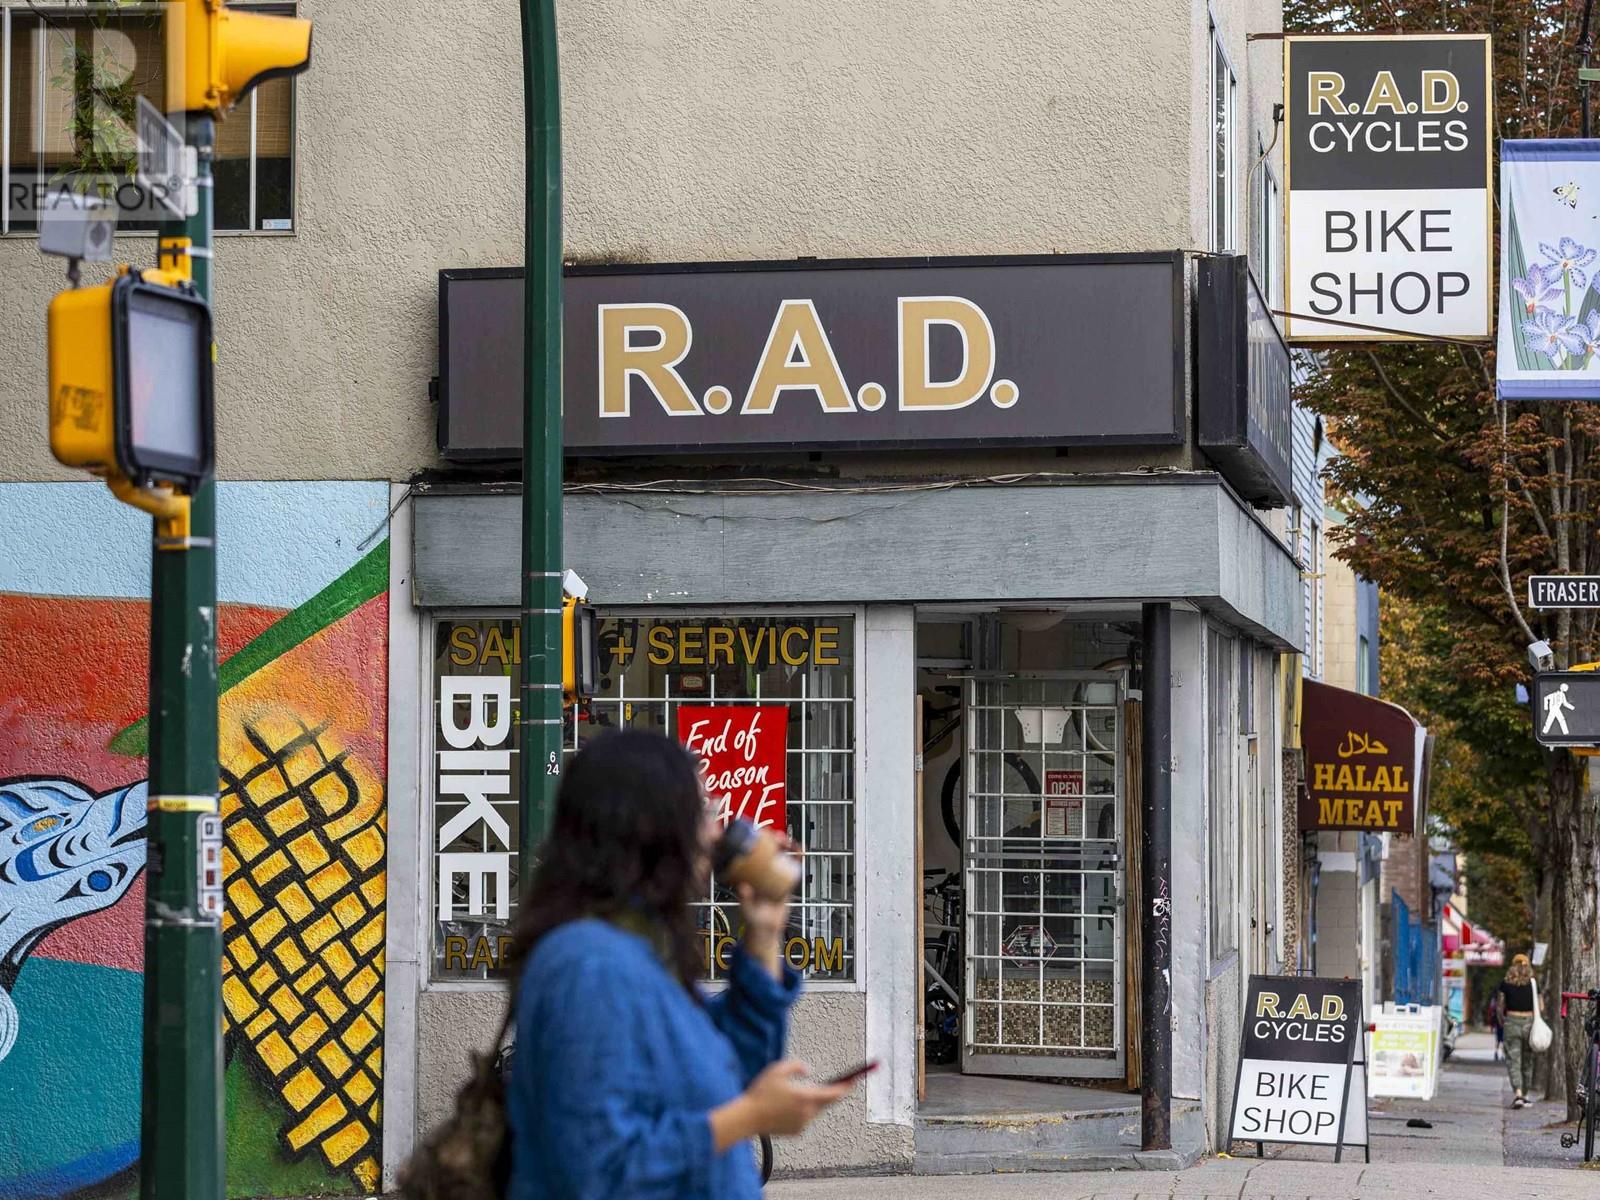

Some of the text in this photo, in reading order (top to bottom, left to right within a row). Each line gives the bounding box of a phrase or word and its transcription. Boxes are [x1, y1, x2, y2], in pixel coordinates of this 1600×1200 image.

[1308, 70, 1469, 115] R.A.D.
[1308, 120, 1469, 153] CYCLES
[1325, 209, 1452, 253] BIKE
[1308, 271, 1470, 315] SHOP
[597, 295, 1021, 419] R.A.D.
[1538, 582, 1599, 602] FRASER
[647, 626, 841, 666] SERVICE
[685, 711, 762, 762] End of
[1338, 731, 1388, 759] حلال
[547, 763, 560, 775] 24
[550, 751, 556, 763] 6
[1051, 781, 1080, 796] OPEN
[1313, 763, 1409, 792] HALAL
[440, 675, 511, 921] BIKE
[1318, 798, 1403, 827] MEAT
[1256, 991, 1348, 1022] R.A.D.
[1254, 1021, 1345, 1043] CYCLES
[1256, 1072, 1330, 1101] BIKE
[1241, 1107, 1336, 1136] SHOP
